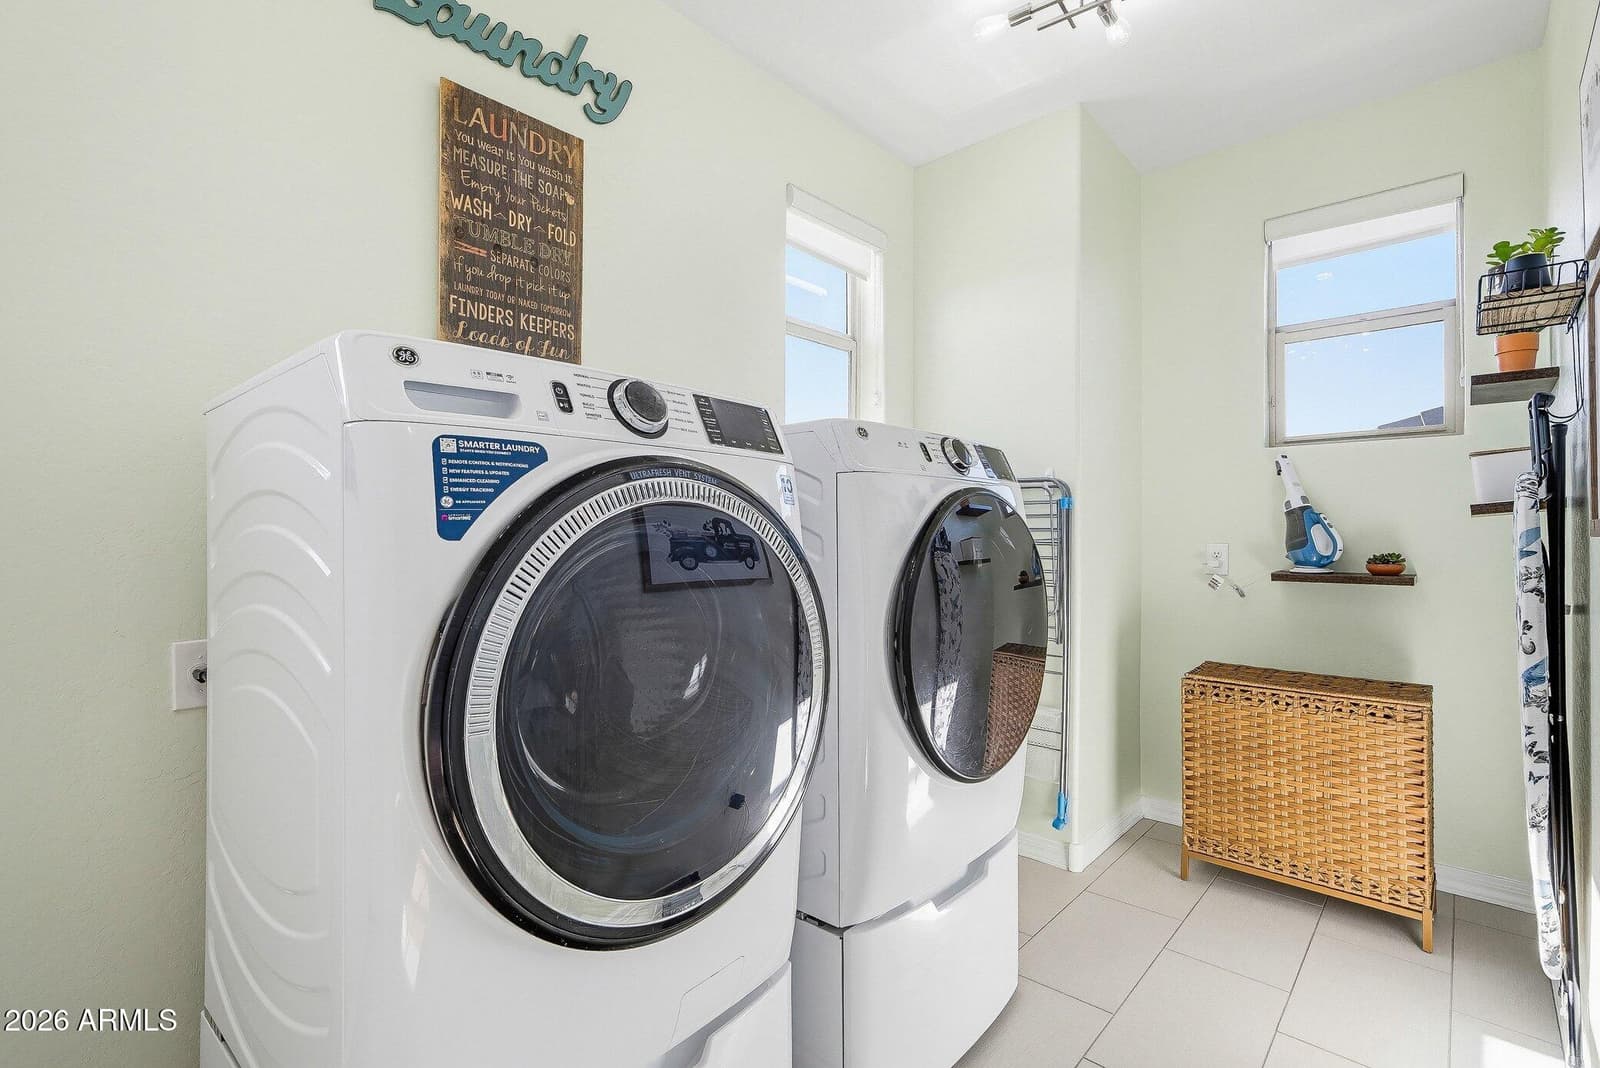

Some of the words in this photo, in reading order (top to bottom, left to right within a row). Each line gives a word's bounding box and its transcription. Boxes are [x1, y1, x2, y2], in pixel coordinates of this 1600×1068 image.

[453, 97, 578, 168] LAUNDRY
[453, 145, 508, 180] MEASURE
[513, 168, 534, 190] THE
[538, 179, 566, 201] SOAP
[455, 129, 474, 146] You
[478, 140, 504, 157] wear
[506, 151, 516, 162] it
[538, 163, 563, 182] wash
[461, 169, 502, 205] Empty
[450, 190, 492, 220] WASH
[508, 209, 532, 233] DRY
[547, 223, 577, 248] FOLD
[465, 264, 485, 282] you
[486, 264, 512, 291] drop
[526, 278, 546, 297] pick
[559, 290, 571, 306] up
[490, 250, 536, 274] SEPARATE
[538, 264, 572, 283] COLORS
[449, 294, 515, 328] FINDERS
[520, 312, 576, 341] KEEPERS
[453, 281, 484, 297] LAUNDRY
[486, 289, 506, 302] TODAY
[518, 297, 538, 311] NAKED
[540, 303, 573, 319] TOMORROW
[453, 320, 513, 348] Loads
[515, 335, 535, 355] of
[458, 440, 501, 450] SMARTER
[502, 443, 540, 454] LAUNDRY
[629, 467, 672, 480] ULTRAFRESH
[674, 469, 691, 478] VENT
[694, 473, 718, 485] SYSTEM
